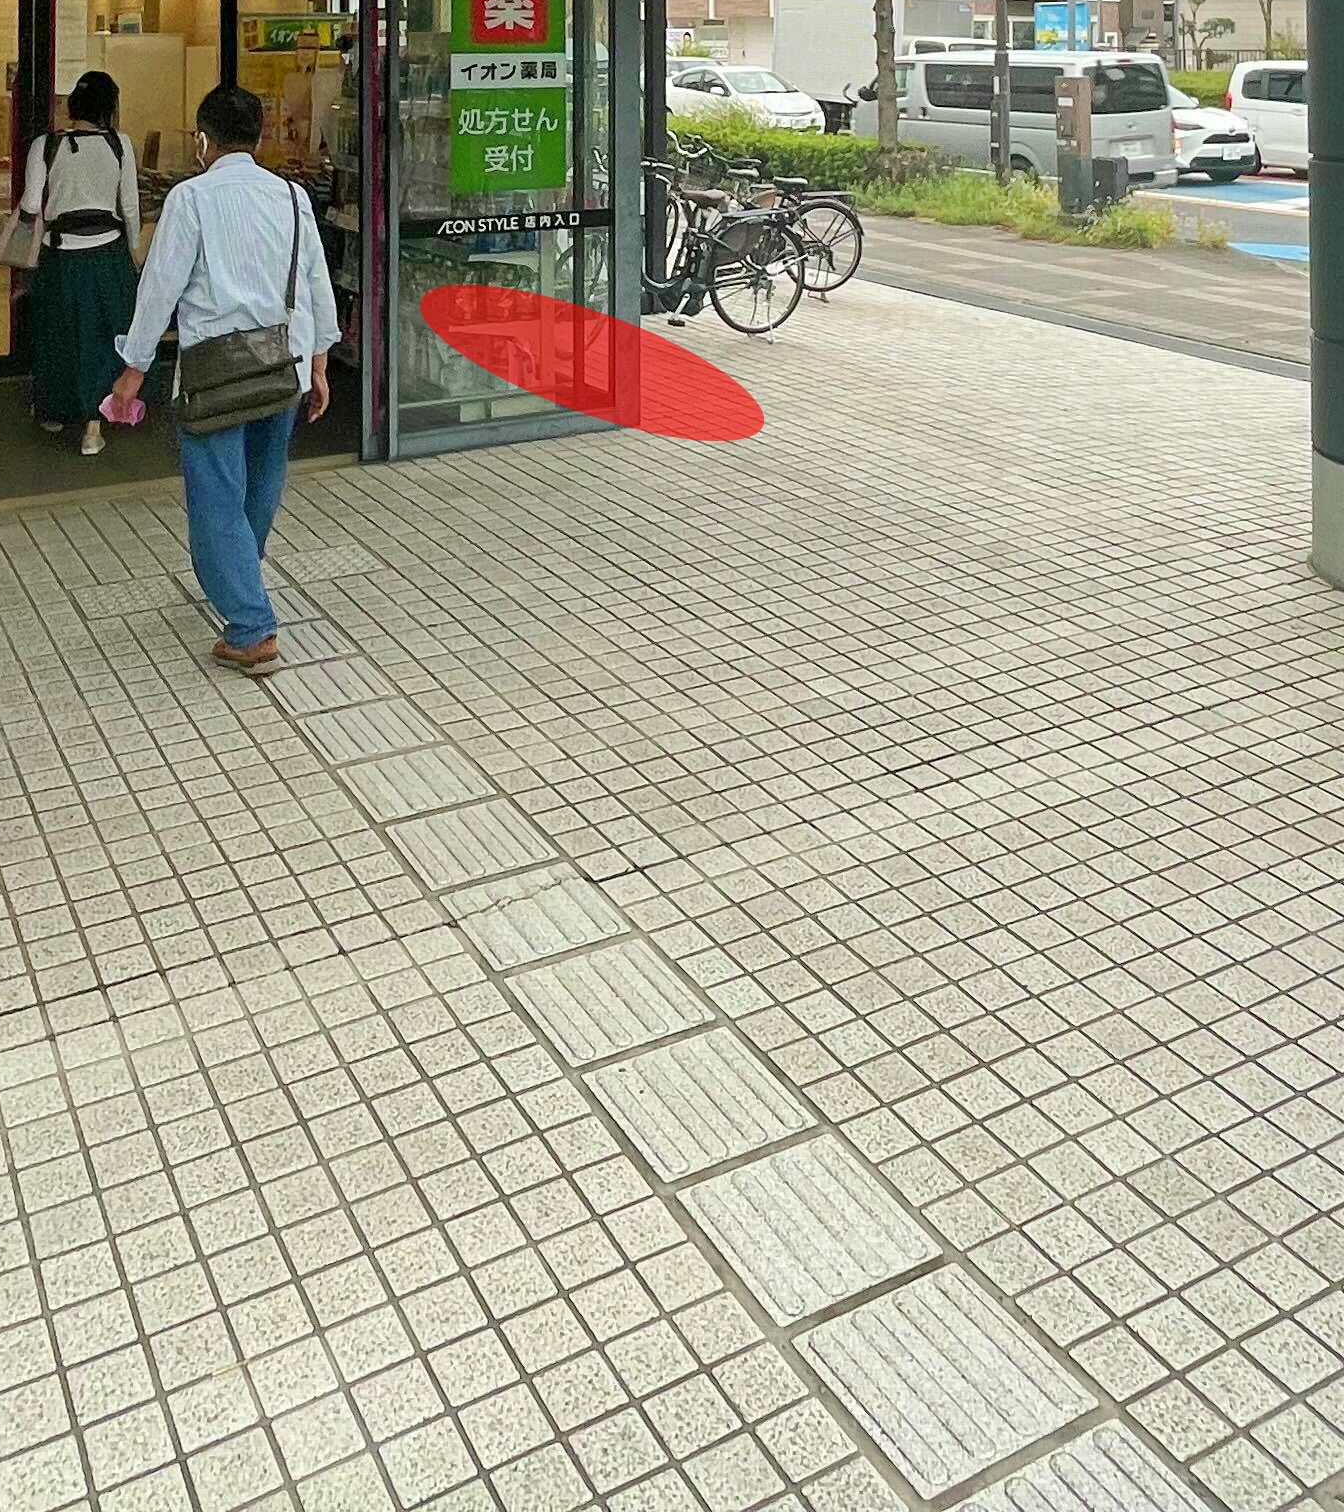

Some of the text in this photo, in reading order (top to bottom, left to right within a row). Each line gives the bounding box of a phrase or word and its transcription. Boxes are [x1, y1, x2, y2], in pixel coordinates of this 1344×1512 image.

[459, 61, 558, 81] イオン薬局
[458, 107, 559, 136] 処方せん
[484, 145, 534, 173] 受付
[477, 216, 520, 232] STYLE
[524, 213, 580, 229] 店内入口
